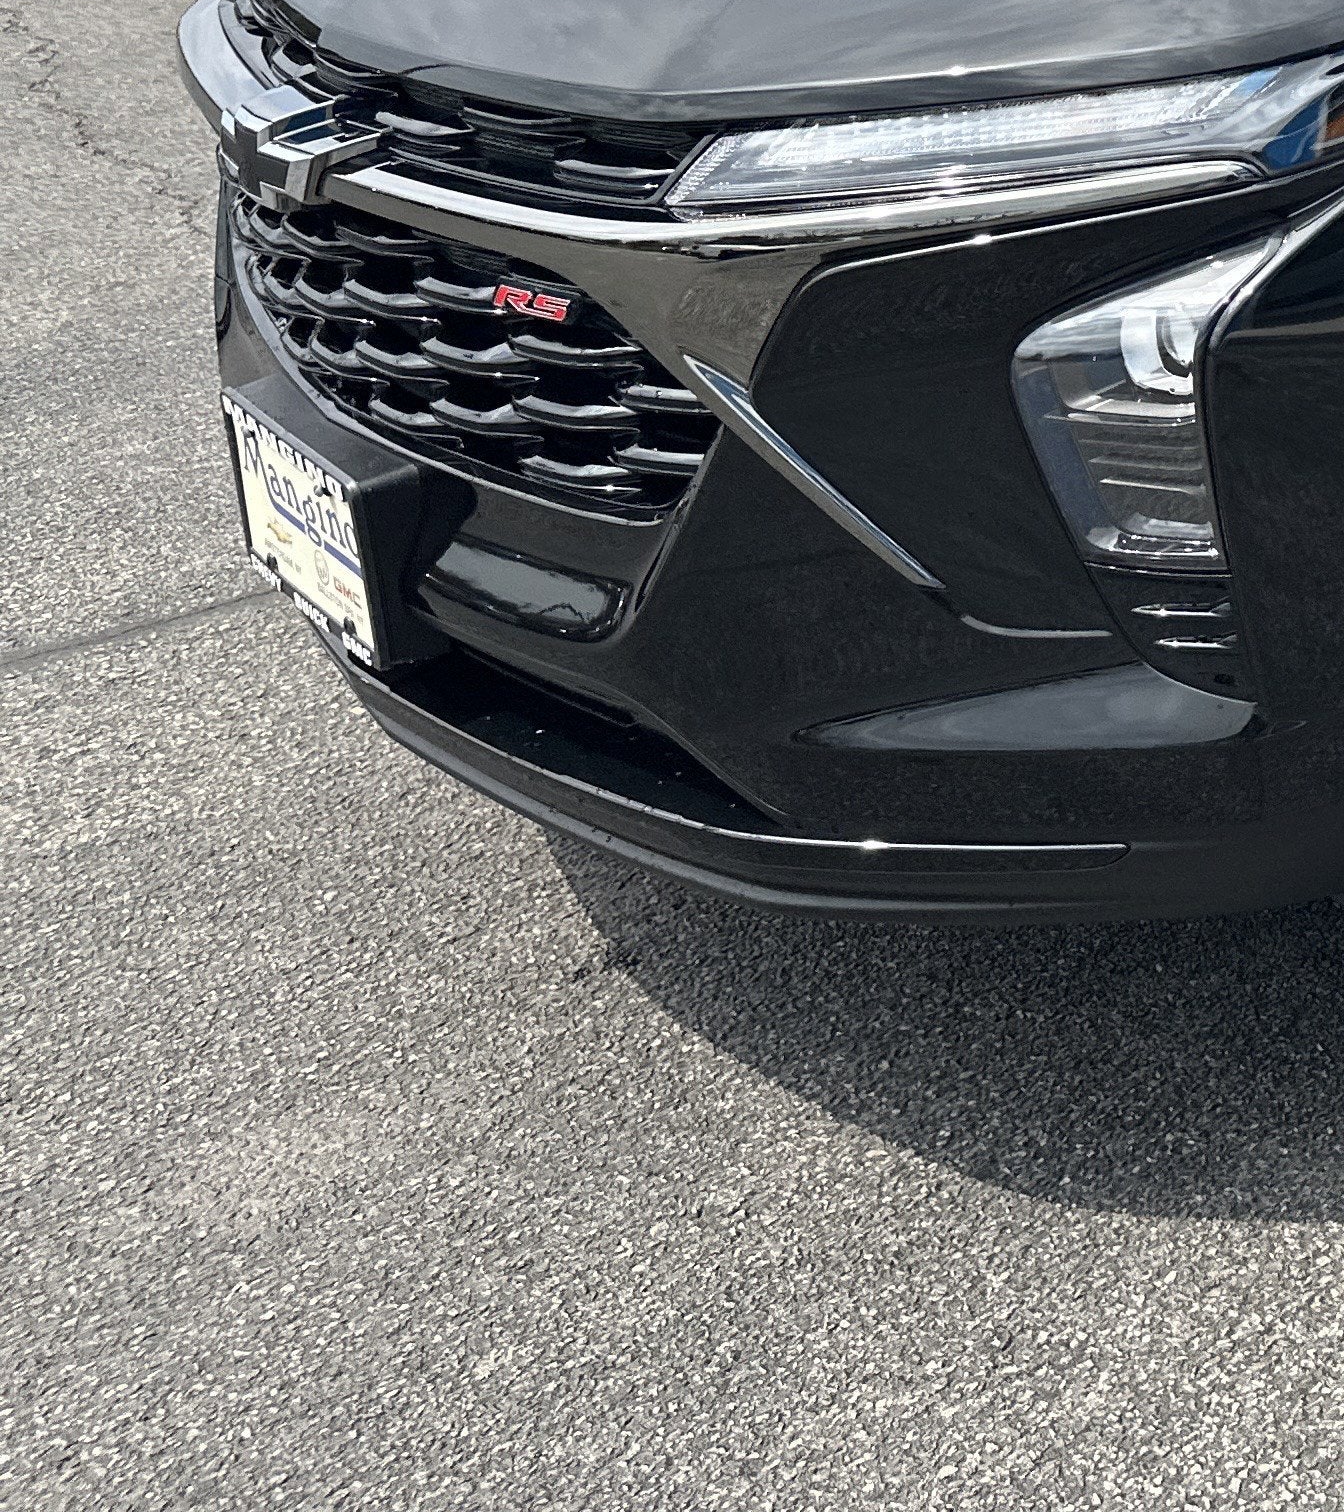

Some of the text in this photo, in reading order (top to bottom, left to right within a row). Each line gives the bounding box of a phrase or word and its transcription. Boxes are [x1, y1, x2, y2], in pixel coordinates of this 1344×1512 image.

[493, 284, 571, 322] RS
[243, 430, 359, 558] Mangino
[293, 591, 331, 633] BUICK
[333, 576, 363, 610] GMC
[341, 632, 373, 666] GMC
